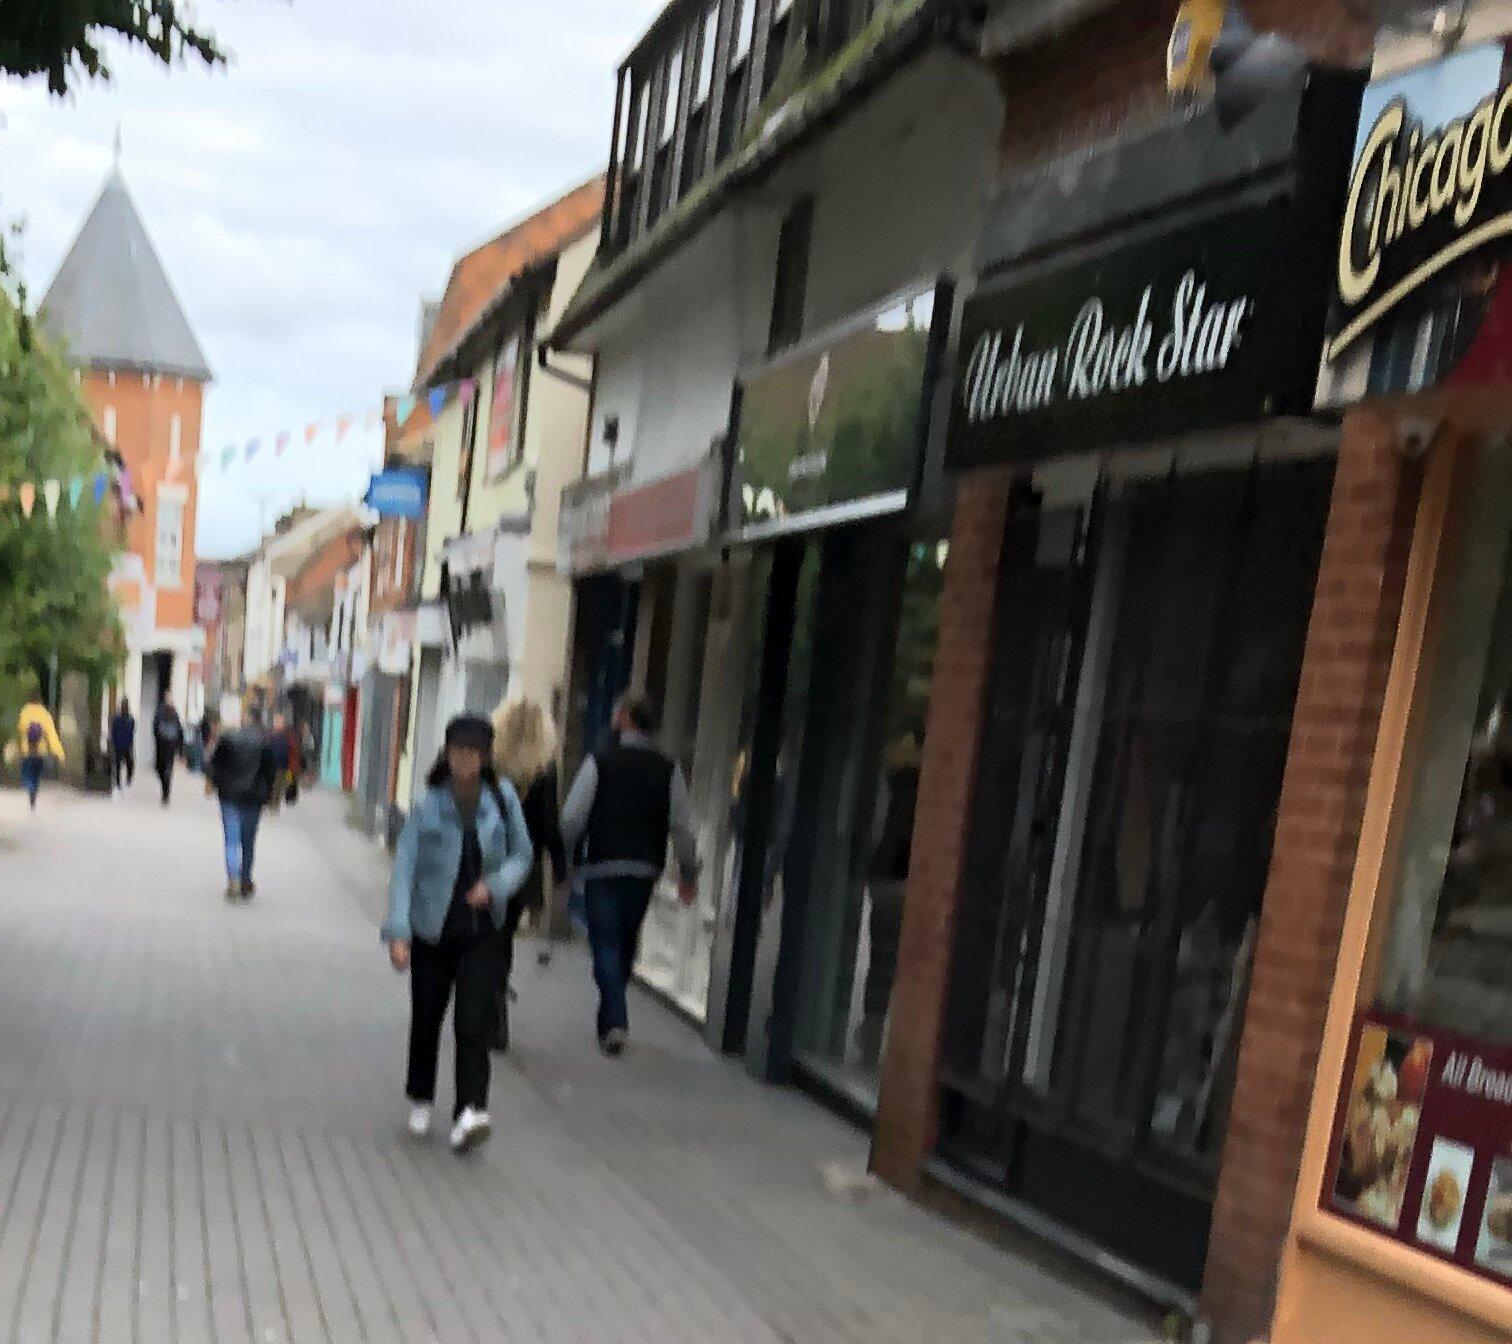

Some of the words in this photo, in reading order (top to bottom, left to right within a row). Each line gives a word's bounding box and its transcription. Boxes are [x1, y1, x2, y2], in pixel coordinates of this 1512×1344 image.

[964, 320, 1058, 425] Urban
[1063, 283, 1153, 400] Rock
[1157, 267, 1252, 383] Star
